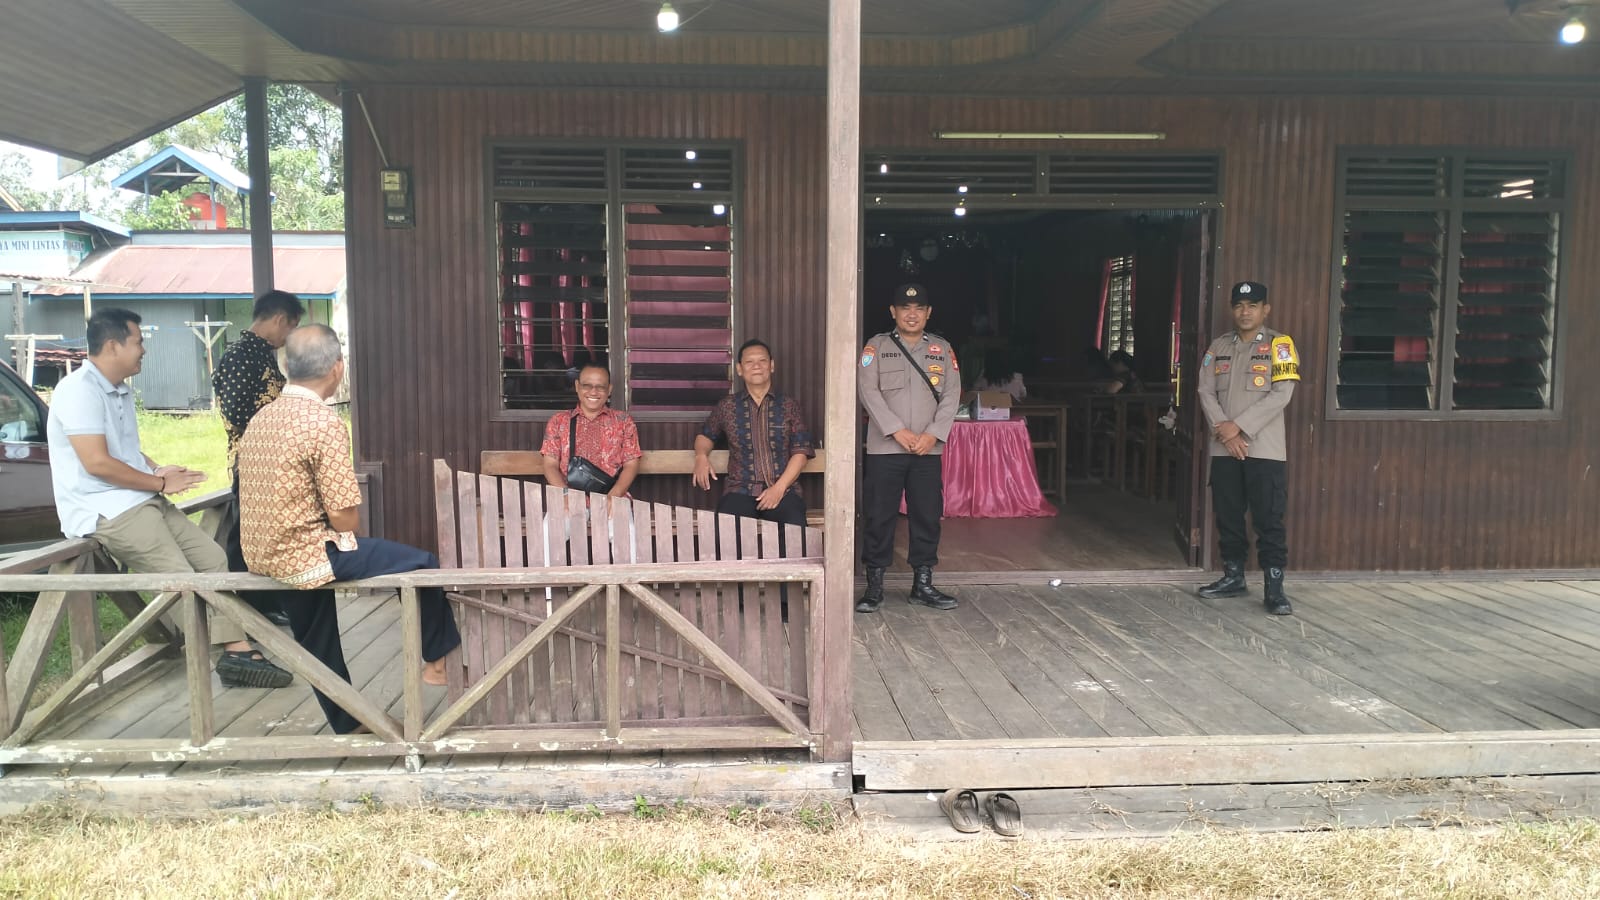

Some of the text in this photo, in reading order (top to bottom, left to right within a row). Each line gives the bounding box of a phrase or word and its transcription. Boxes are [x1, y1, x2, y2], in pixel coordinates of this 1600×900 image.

[11, 240, 30, 251] MINI
[32, 240, 61, 251] LINTAS
[924, 354, 945, 362] POLRI
